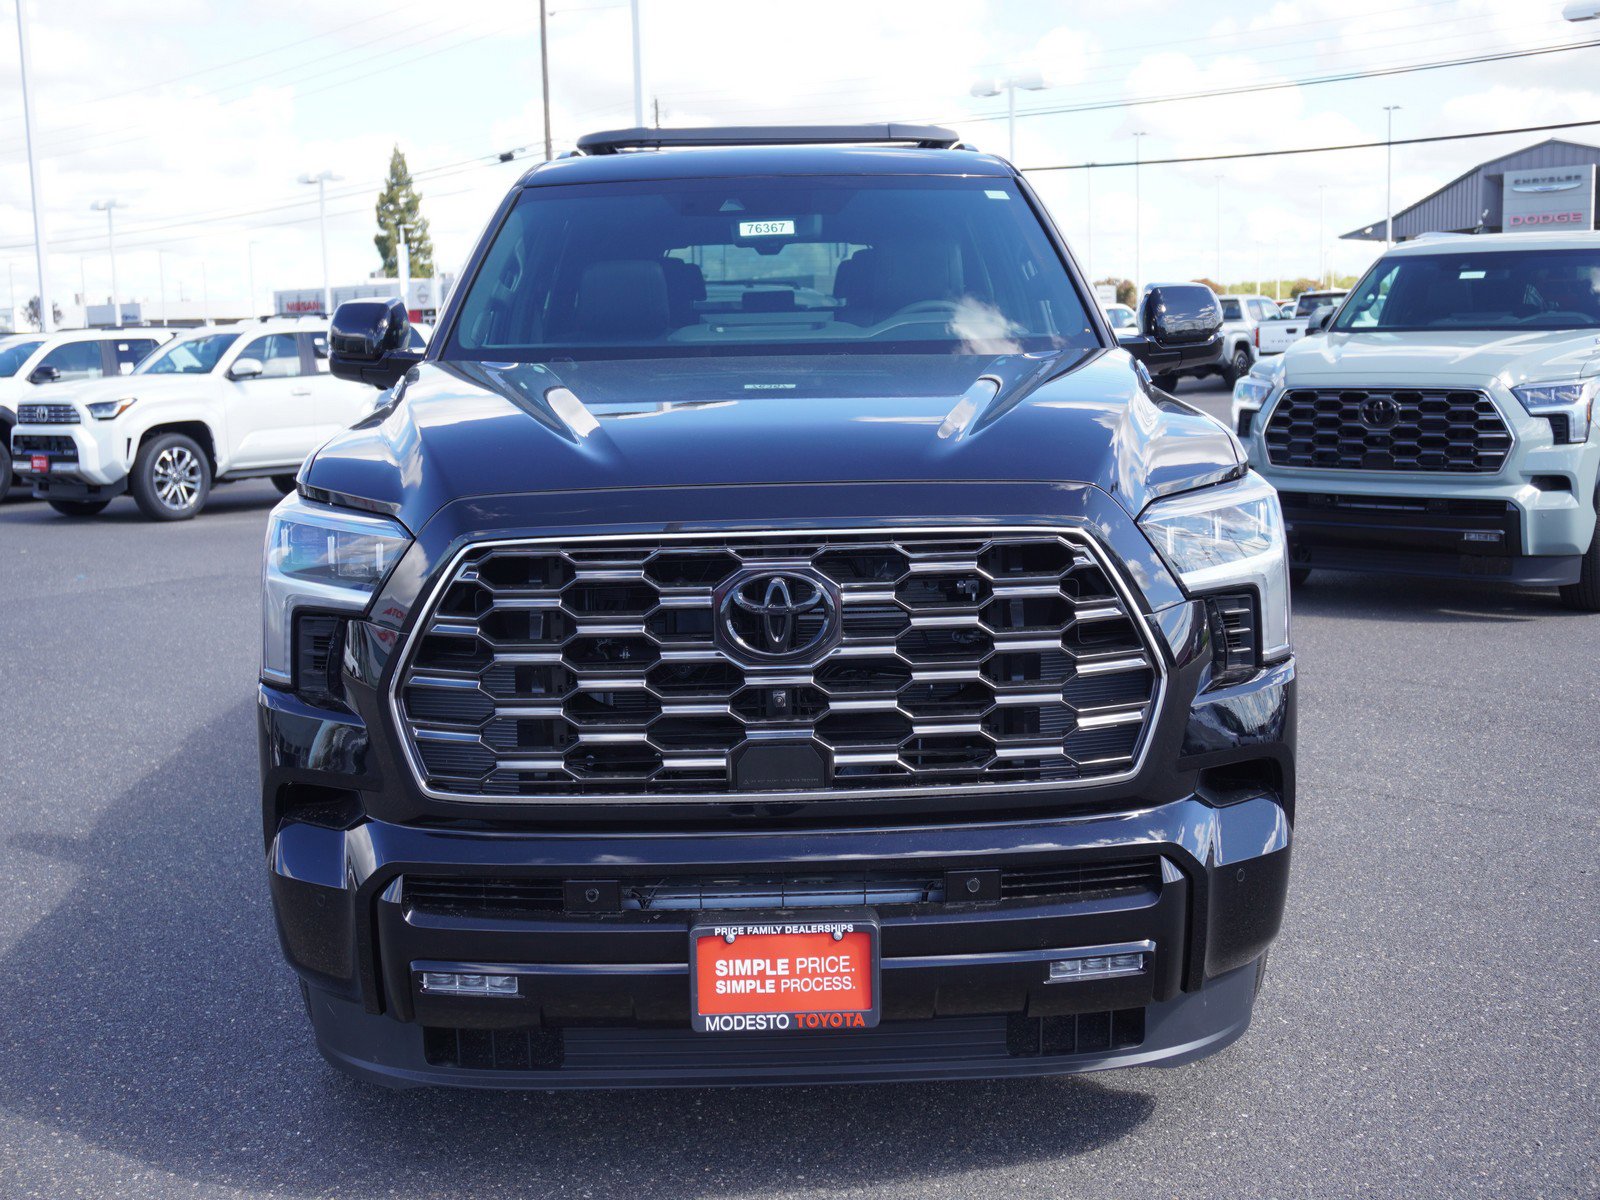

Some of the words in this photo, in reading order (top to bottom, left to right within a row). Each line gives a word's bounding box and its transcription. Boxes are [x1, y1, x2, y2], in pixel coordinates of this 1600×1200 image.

[1510, 212, 1583, 226] DODGE
[747, 223, 785, 234] 76367
[286, 301, 321, 312] NISSAN
[714, 927, 744, 936] PRICE
[747, 925, 782, 935] FAMILY
[785, 924, 854, 934] DEALERSHIPS
[715, 958, 789, 976] SIMPLE
[796, 956, 855, 974] PRICE.
[715, 979, 775, 994] SIMPLE
[781, 976, 856, 993] PROCESS.
[705, 1014, 789, 1031] MODESTO
[794, 1012, 865, 1028] TOYOTA
